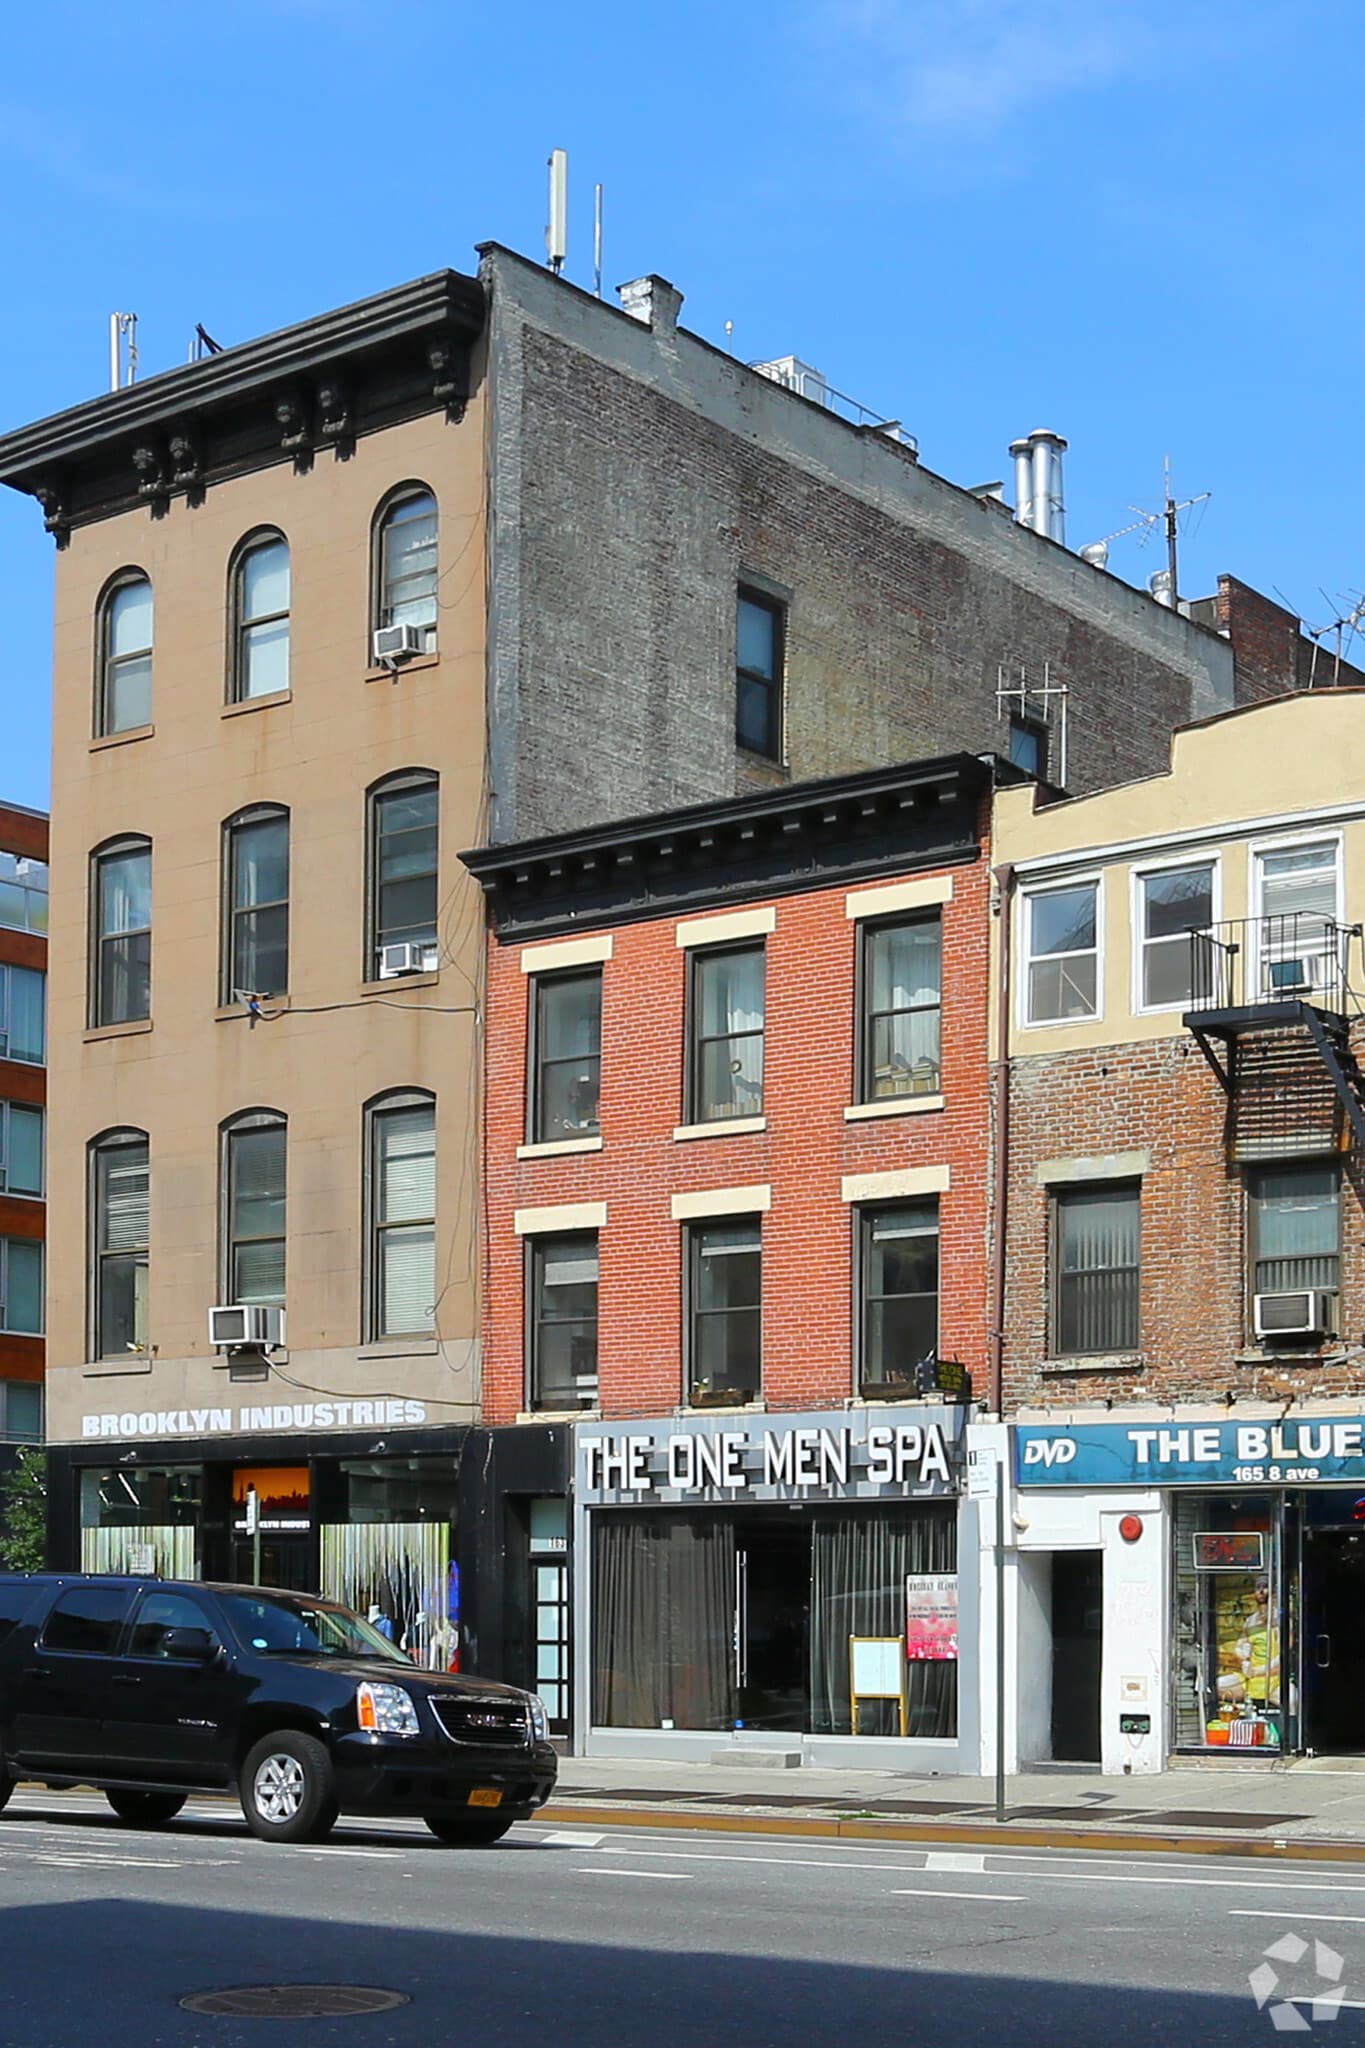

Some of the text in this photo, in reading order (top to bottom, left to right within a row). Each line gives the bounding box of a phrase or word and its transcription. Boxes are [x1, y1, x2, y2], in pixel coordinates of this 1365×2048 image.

[82, 1400, 426, 1438] BROOKLYN INDUSTRIES
[579, 1423, 950, 1490] THE ONE MEN SPA
[1023, 1423, 1364, 1468] DVD THE BLUE
[1232, 1465, 1320, 1481] 165 8 ave
